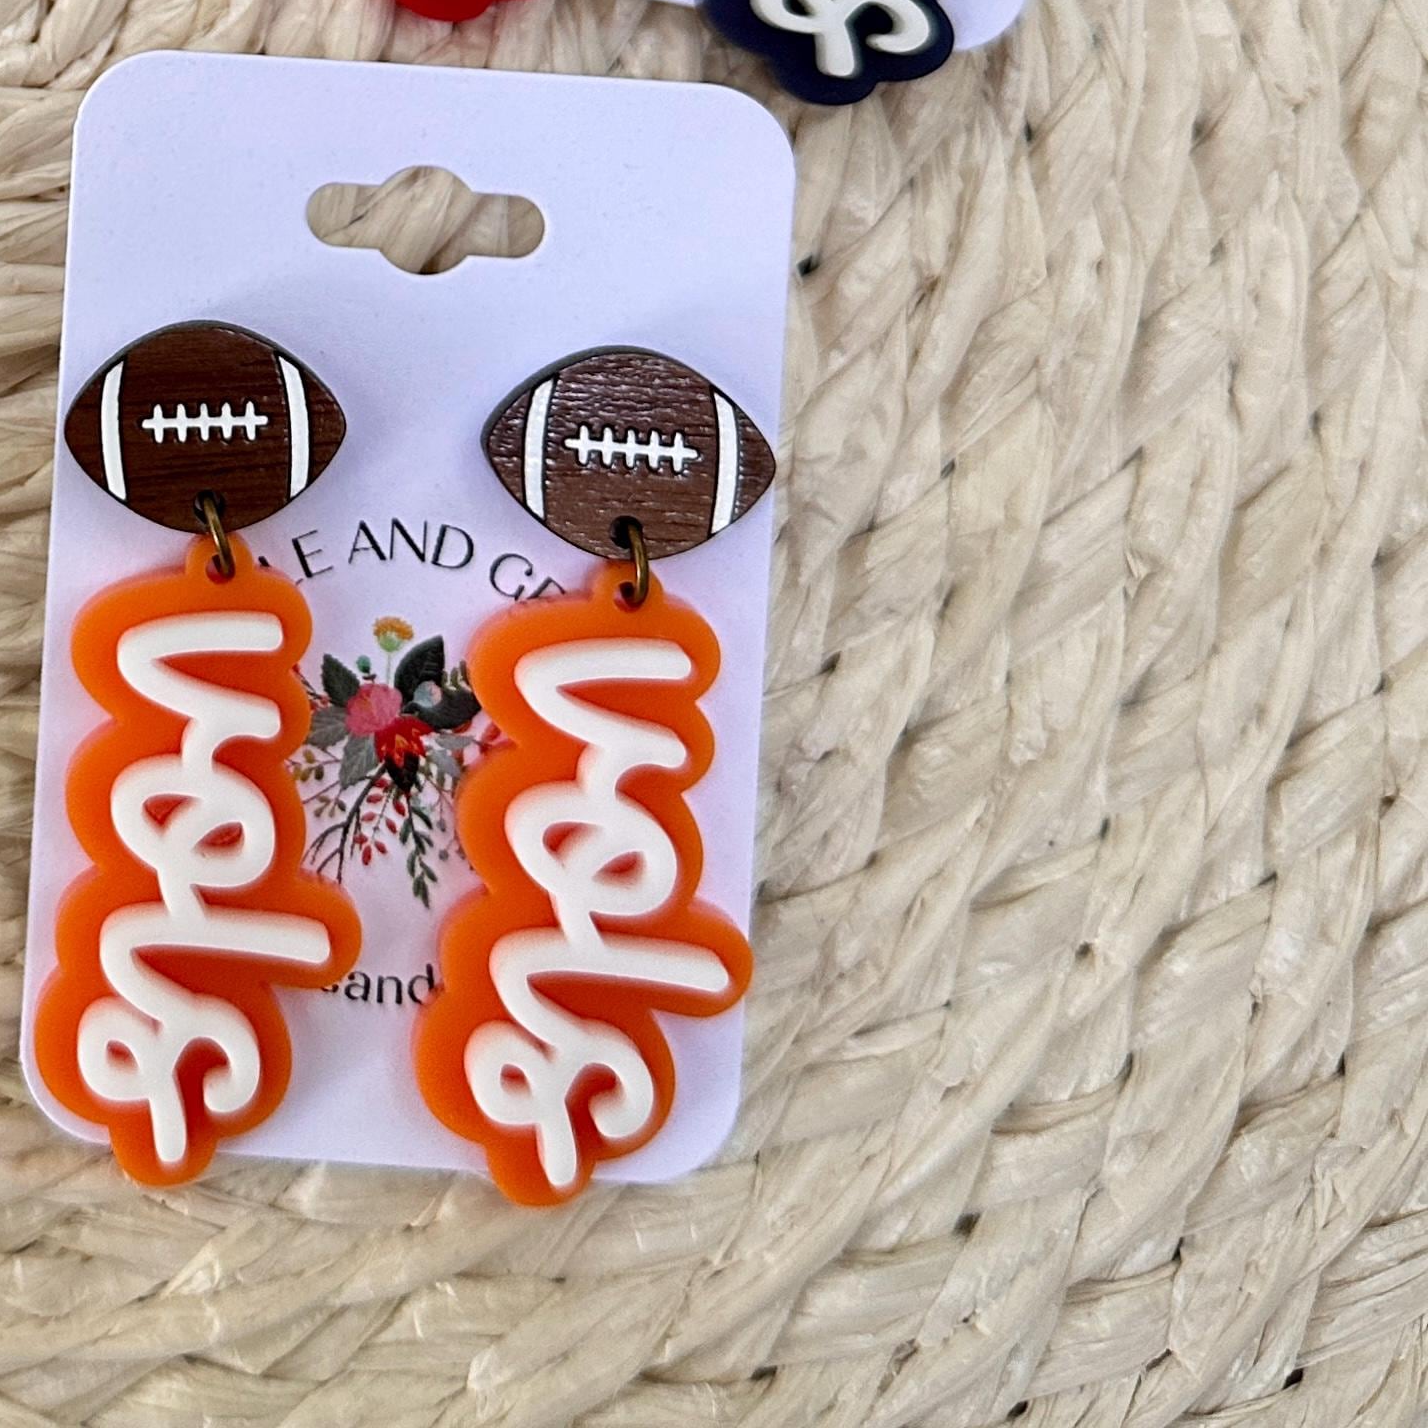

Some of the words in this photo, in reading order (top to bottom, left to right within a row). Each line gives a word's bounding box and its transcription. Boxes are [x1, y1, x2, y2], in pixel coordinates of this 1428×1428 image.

[348, 518, 474, 569] AND
[78, 612, 330, 1163] vols
[463, 637, 730, 1186] vols
